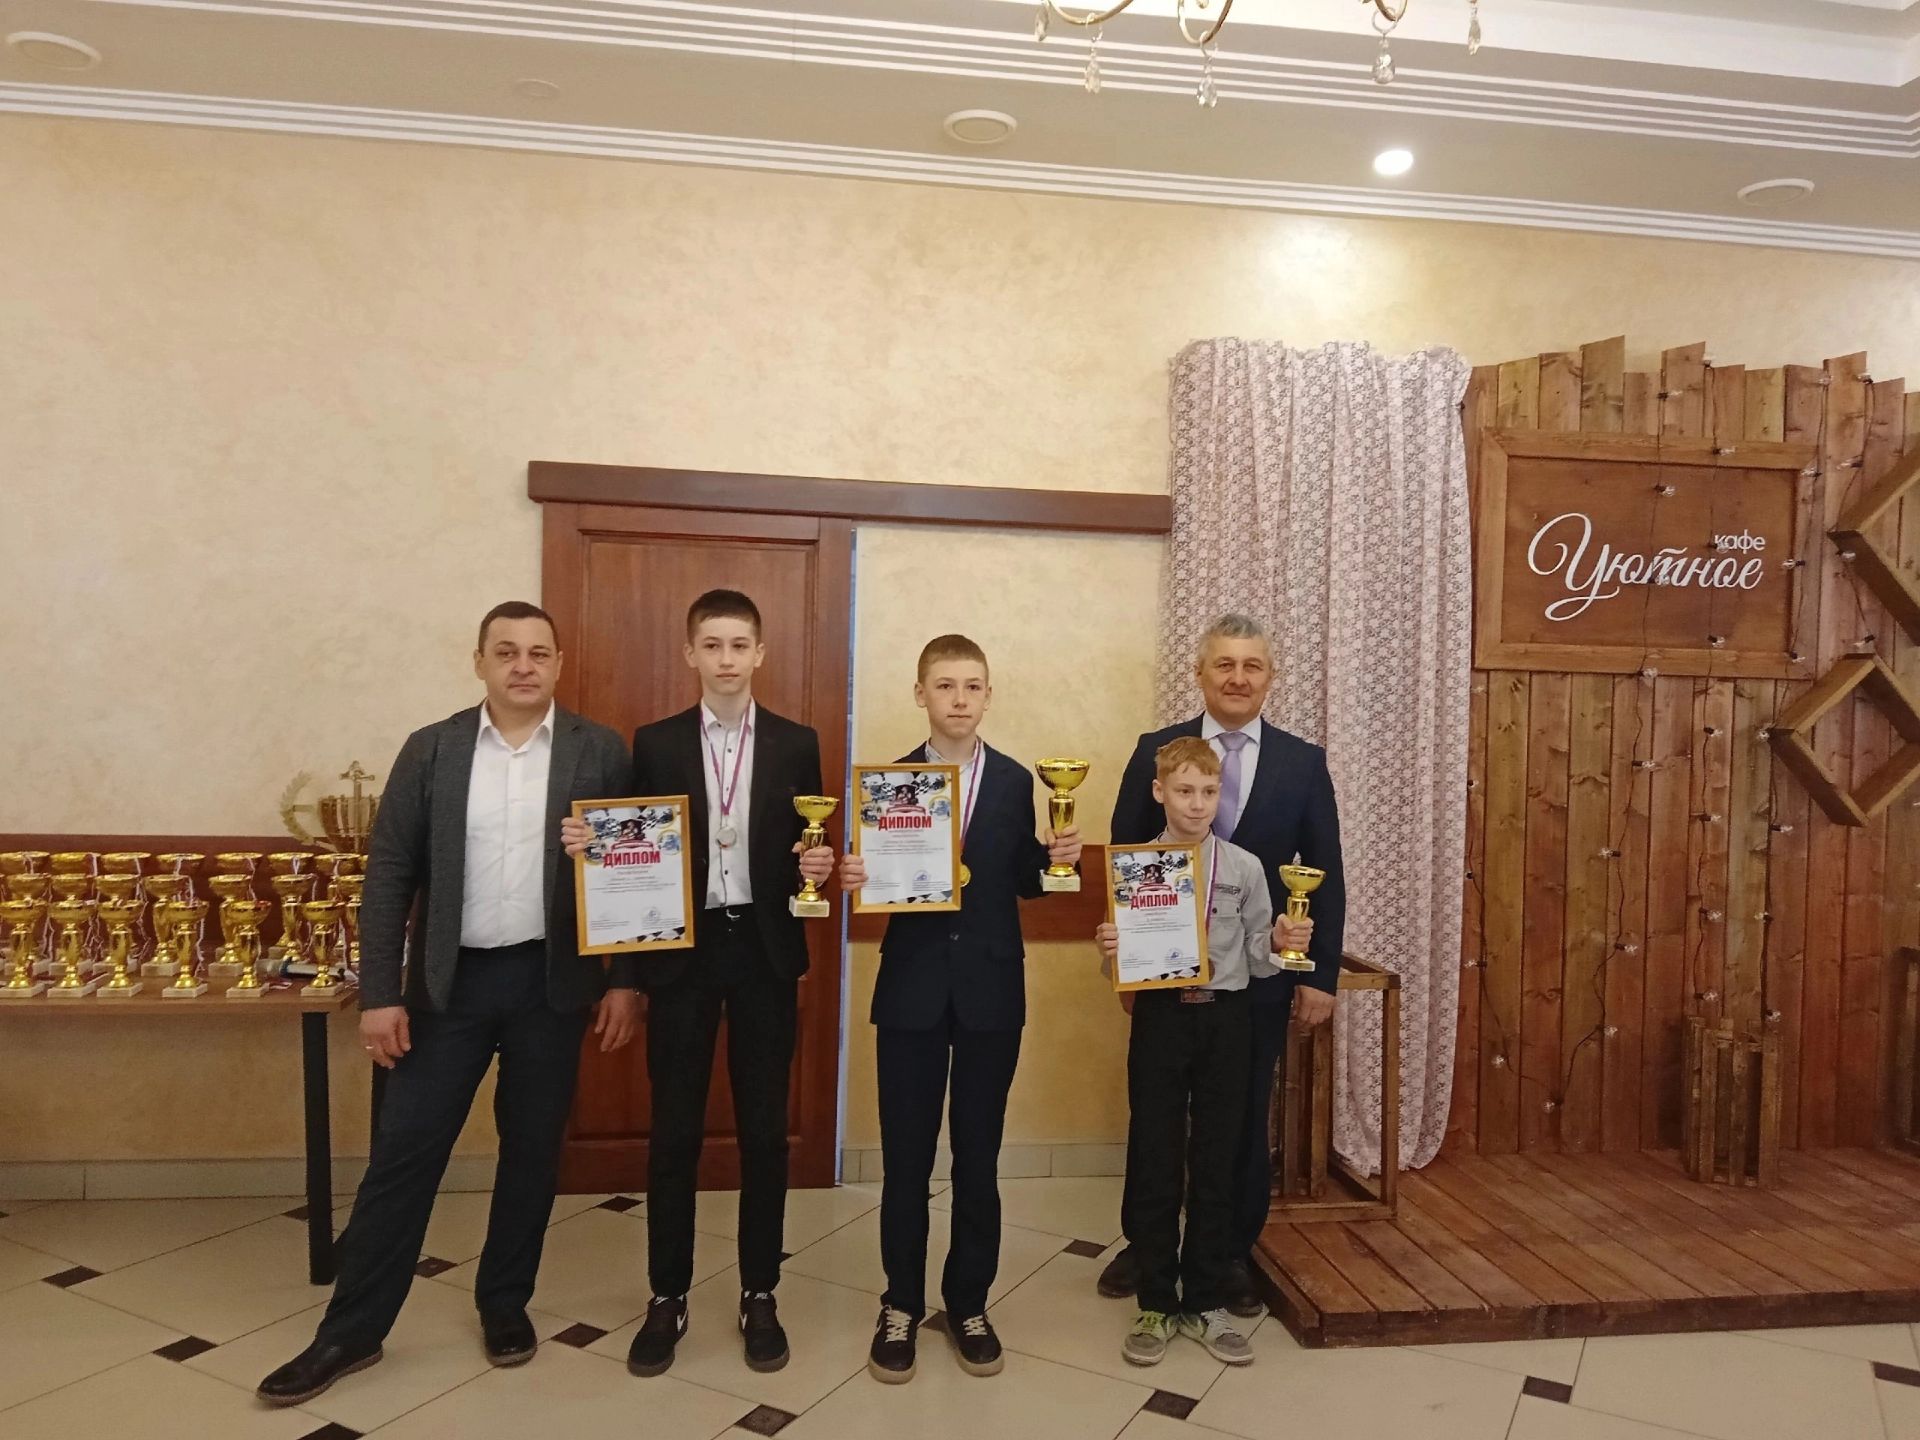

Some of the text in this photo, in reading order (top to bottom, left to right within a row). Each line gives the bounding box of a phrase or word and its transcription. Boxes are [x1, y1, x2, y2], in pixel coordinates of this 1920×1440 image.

[1714, 529, 1765, 554] кафе
[1527, 514, 1763, 621] Уютное
[879, 816, 932, 831] ДИПЛОМ
[603, 851, 660, 868] ДИПЛОМ
[1131, 894, 1178, 909] ДИПЛОМ
